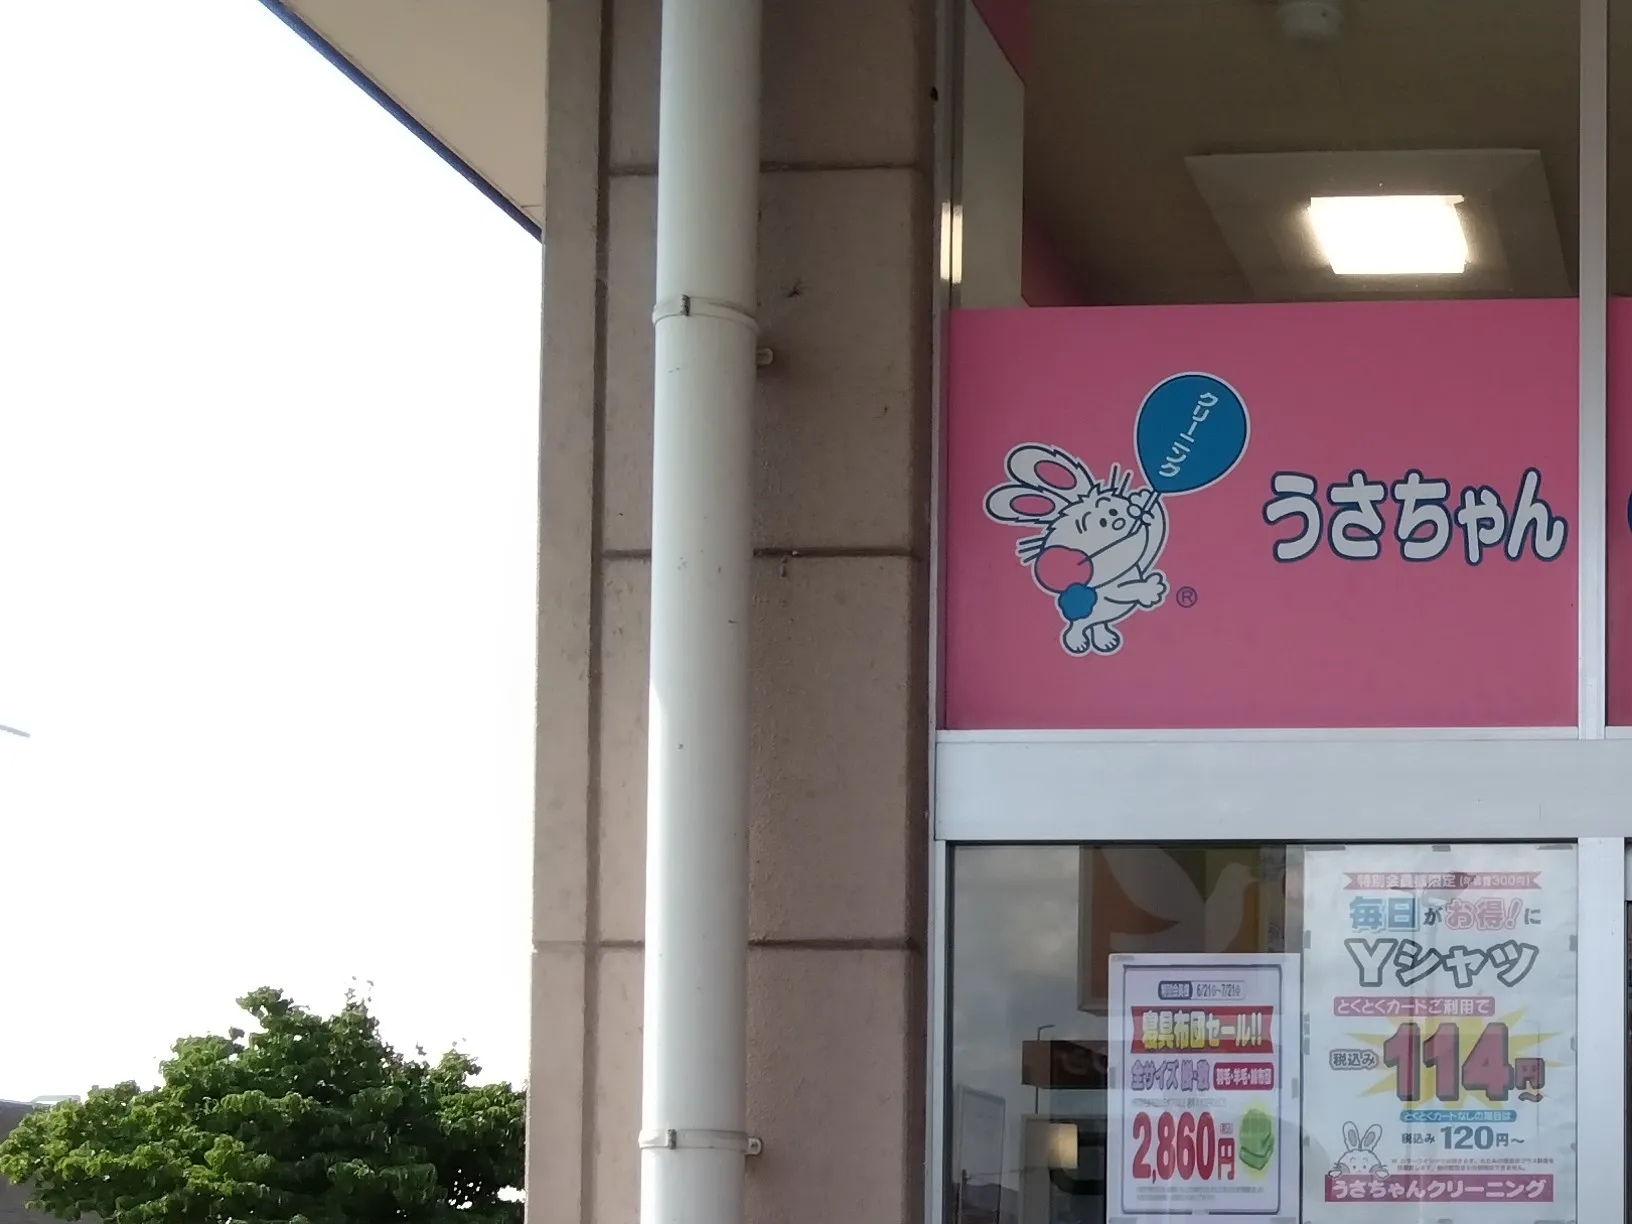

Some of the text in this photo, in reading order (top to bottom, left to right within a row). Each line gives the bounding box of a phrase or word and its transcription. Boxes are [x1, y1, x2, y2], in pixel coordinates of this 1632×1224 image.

[1158, 391, 1220, 479] クリーニング
[1263, 467, 1569, 565] うさちゃん
[1344, 938, 1539, 988] Yシャツ
[1336, 999, 1491, 1014] とくとくカードご利用で
[1331, 1051, 1378, 1068] 税込み
[1132, 1111, 1236, 1184] 2,860円
[1332, 1179, 1546, 1200] うさちゃんクリーニング
